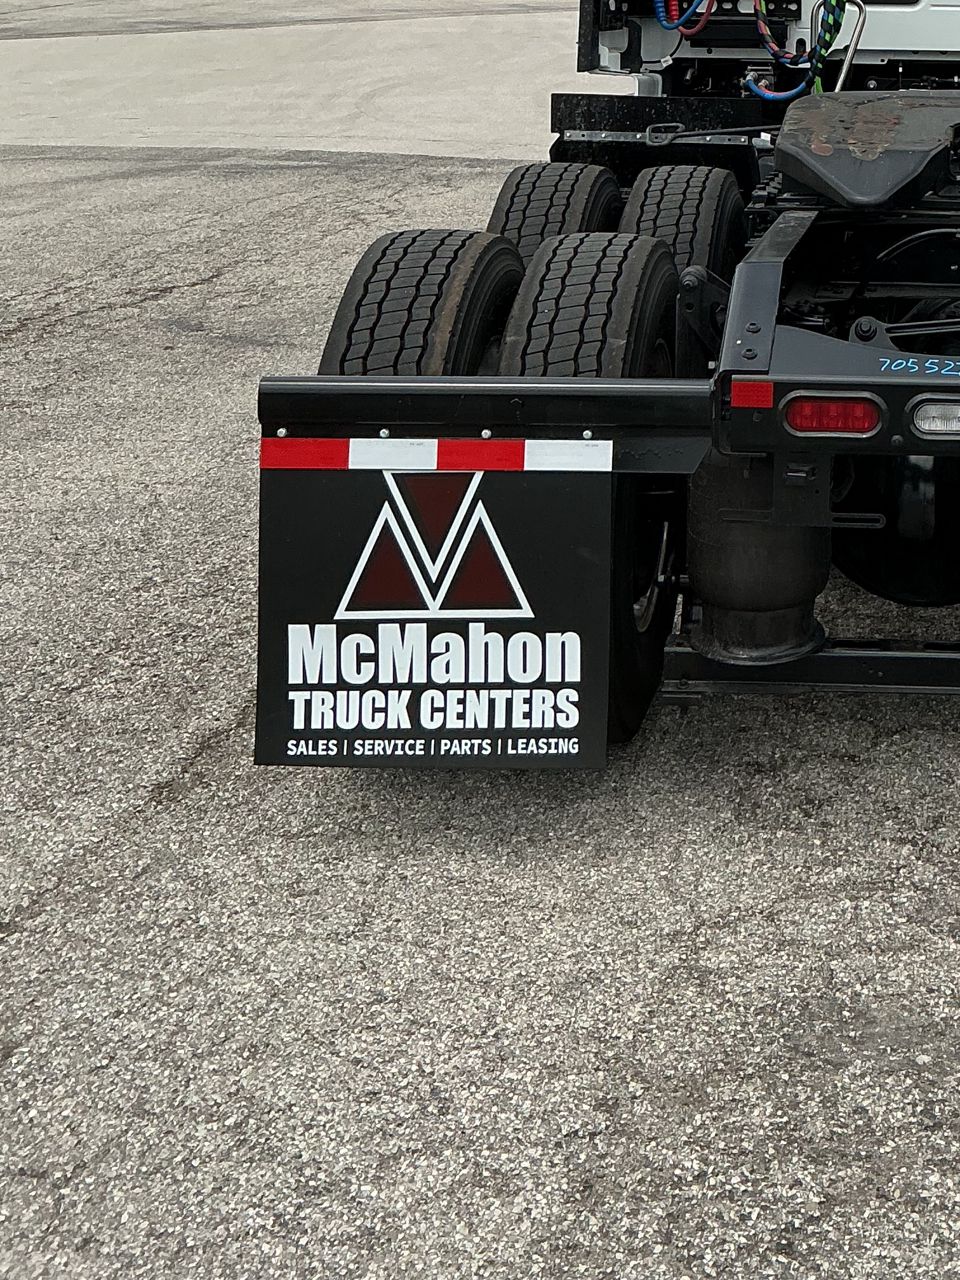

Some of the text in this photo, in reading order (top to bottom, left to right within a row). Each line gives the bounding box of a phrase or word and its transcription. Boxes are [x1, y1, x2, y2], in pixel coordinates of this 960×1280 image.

[287, 622, 582, 686] McMahon
[287, 688, 580, 730] TRUCK CENTERS
[286, 739, 338, 756] SALES
[353, 739, 426, 756] SERVICE
[440, 738, 492, 755] PARTS
[507, 737, 579, 755] LEASING
